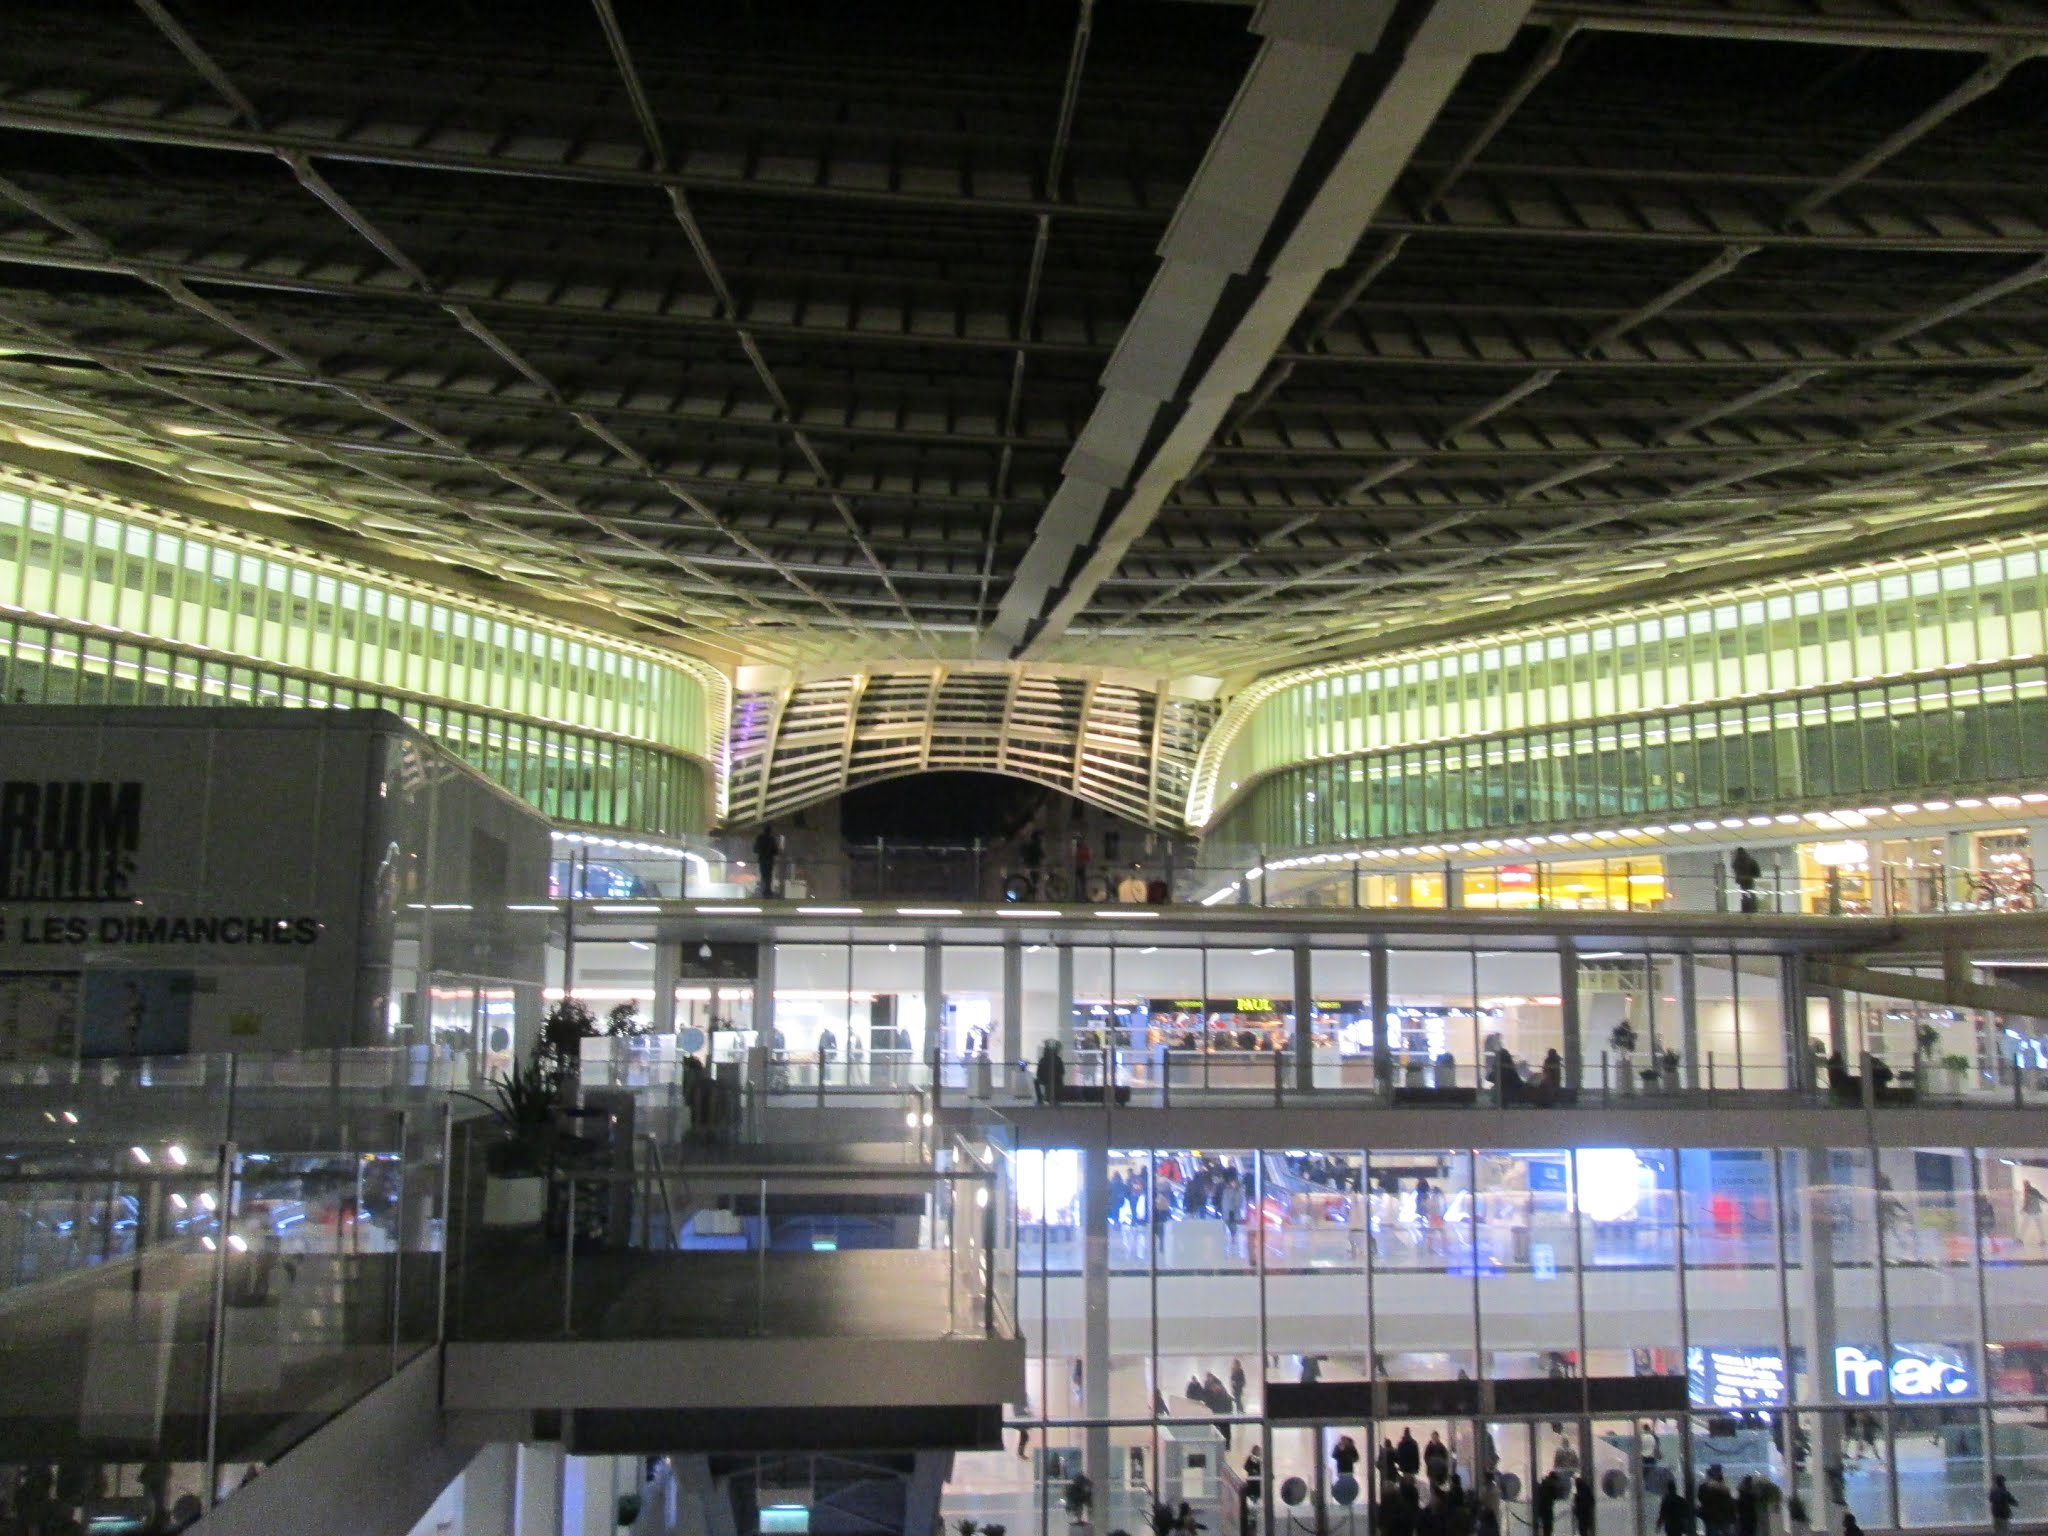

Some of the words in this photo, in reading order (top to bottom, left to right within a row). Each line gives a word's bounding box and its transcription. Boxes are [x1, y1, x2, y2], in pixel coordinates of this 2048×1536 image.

[21, 916, 88, 945] LES
[100, 916, 319, 945] DIMANCHES
[1236, 998, 1272, 1011] PAUL
